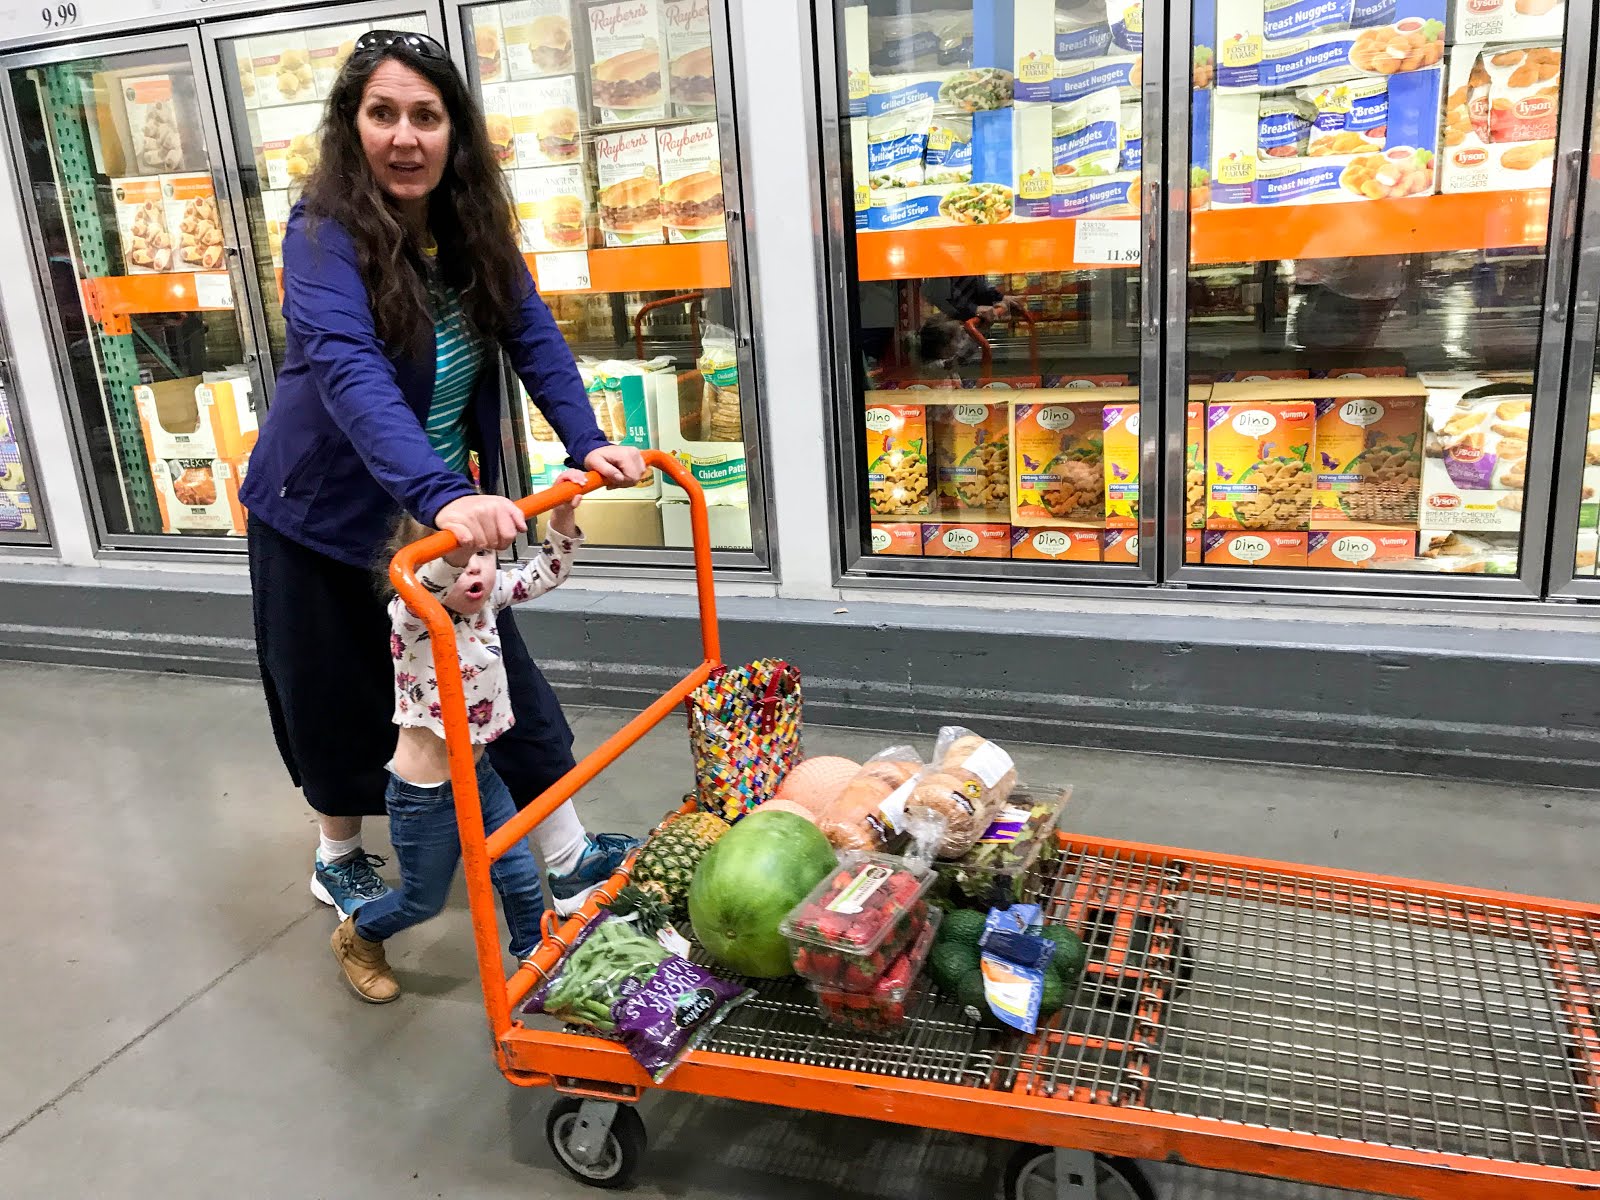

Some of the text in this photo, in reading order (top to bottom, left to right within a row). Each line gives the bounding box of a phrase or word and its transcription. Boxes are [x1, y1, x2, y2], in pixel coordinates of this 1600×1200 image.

[1264, 1, 1337, 32] Breast Nuggets
[1355, 2, 1387, 18] Breast
[42, 6, 77, 28] 9.99
[1464, 20, 1504, 30] CHICKEN
[1464, 27, 1503, 36] NUGGETS
[1059, 38, 1087, 52] Breast
[1226, 44, 1258, 54] FOSTER
[1230, 52, 1256, 60] FARMS
[1275, 47, 1343, 73] Breast Nuggets
[1022, 62, 1051, 72] FOSTER
[1025, 69, 1048, 77] FARMS
[1064, 68, 1124, 92] Breast Nuggets
[881, 91, 929, 110] Grilled Strips
[1519, 100, 1551, 113] Tyson
[1356, 101, 1389, 117] Breast
[1260, 122, 1291, 135] Breast
[660, 127, 714, 157] Raybern's
[1069, 130, 1103, 150] Nuggets
[597, 133, 648, 162] Raybern's
[895, 144, 919, 158] Strips
[1458, 152, 1485, 161] Tyson
[1222, 163, 1252, 172] FOSTER
[1023, 180, 1049, 188] FOSTER
[1268, 171, 1334, 193] Breast Nuggets
[1450, 173, 1488, 182] CHICKEN
[1450, 180, 1487, 188] NUGGETS
[1064, 196, 1089, 207] Breast
[1089, 187, 1122, 201] Nuggets
[882, 205, 929, 223] Grilled Strips
[1105, 248, 1141, 261] 11.89
[866, 408, 920, 422] Dino Yummy
[958, 405, 984, 416] Dino
[1042, 408, 1069, 421] Dino
[1346, 402, 1378, 415] Dino
[1240, 413, 1269, 426] Dino
[1280, 411, 1308, 420] Yummy
[629, 426, 635, 436] 5
[698, 468, 727, 479] Chicken
[1433, 496, 1458, 506] Tyson
[894, 530, 915, 539] Yummy
[948, 530, 1005, 543] Dino Yummy
[1038, 532, 1098, 545] Dino Yummy
[1235, 537, 1301, 551] Dino Yummy
[1339, 537, 1408, 552] Dino Yummy
[662, 958, 695, 980] NAP
[649, 969, 701, 1014] SUGAR
[626, 980, 667, 1020] PEAS
